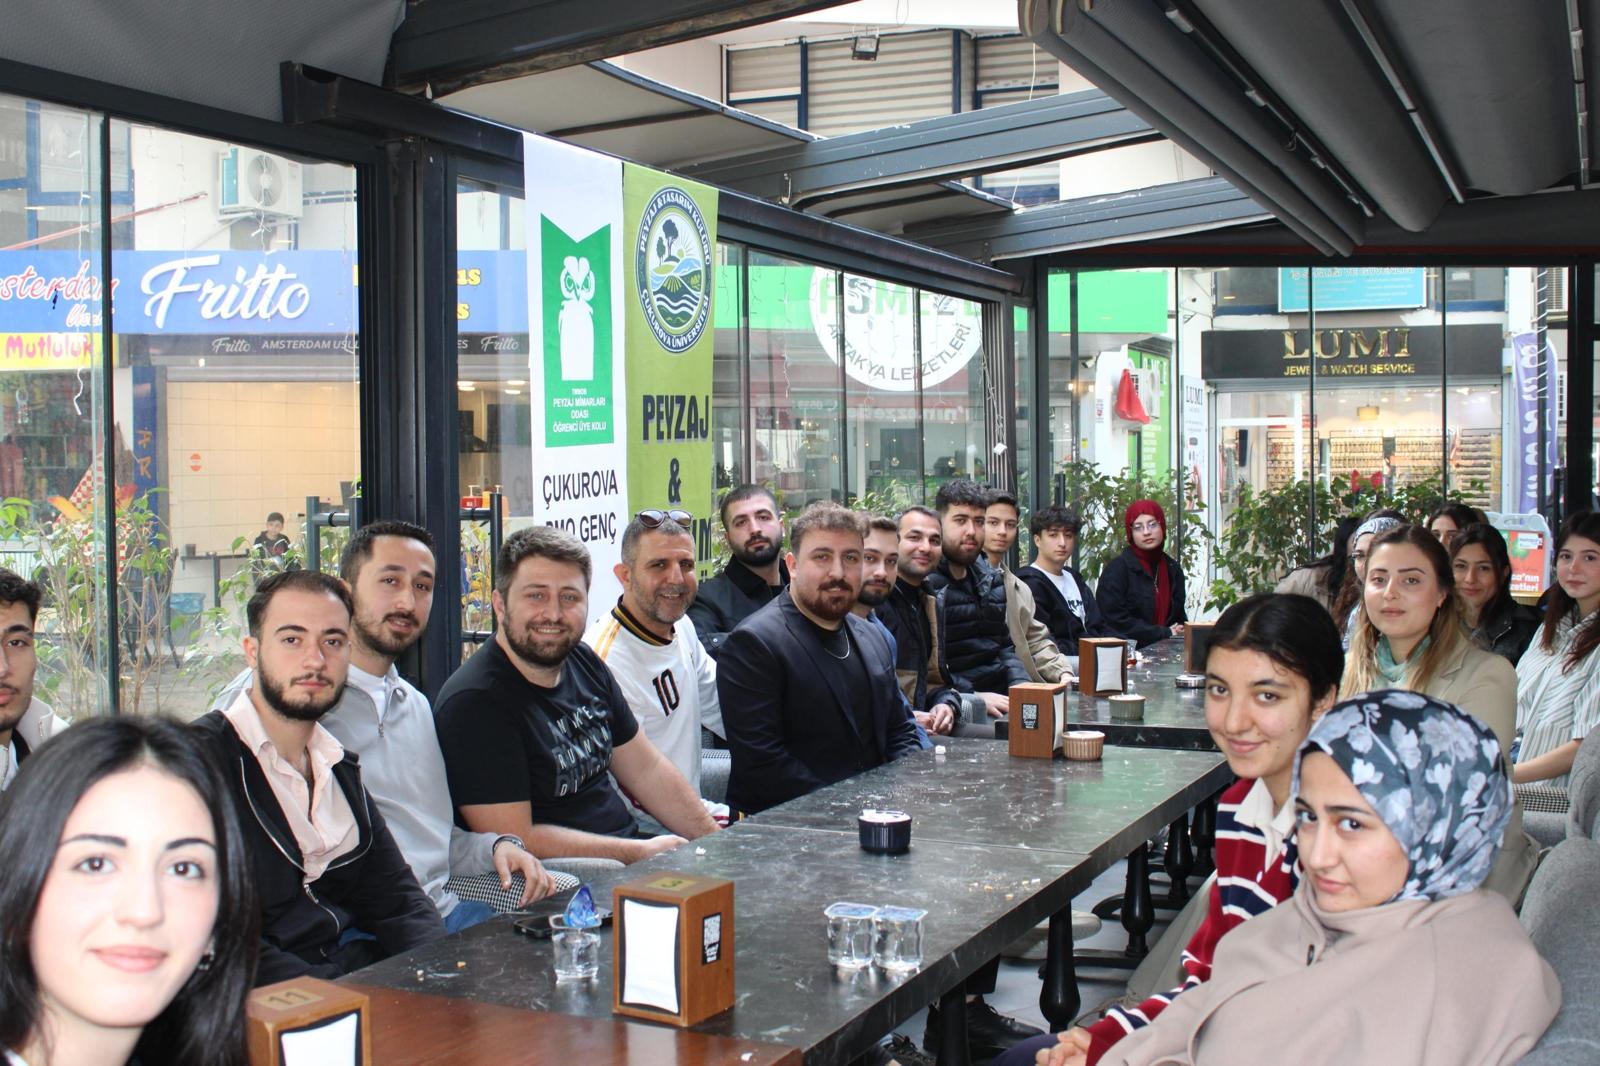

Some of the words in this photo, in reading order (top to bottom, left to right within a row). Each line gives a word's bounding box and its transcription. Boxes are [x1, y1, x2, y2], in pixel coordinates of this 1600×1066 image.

[639, 203, 658, 252] PEYZAJ
[661, 190, 693, 213] TASARIM
[691, 207, 712, 265] KULÜBÜ
[0, 259, 119, 300] sterda
[140, 254, 310, 329] Fritto
[641, 288, 672, 348] ÇUKUROVA
[6, 334, 92, 359] Mutluluk
[211, 336, 250, 354] Fritto
[261, 339, 331, 350] AMSTERDAM
[333, 339, 360, 350] USUL
[480, 335, 520, 352] Fritto
[827, 322, 886, 380] ATAKYA
[1282, 328, 1412, 360] LUMI
[1331, 364, 1368, 376] WATCH
[1370, 363, 1415, 374] SERVICE
[553, 397, 574, 408] PEYZAJ
[570, 409, 589, 419] ODASI
[642, 394, 709, 441] PEYZAJ
[591, 420, 607, 431] KOLU
[543, 469, 618, 510] ÇUKUROVA
[668, 457, 682, 503] &
[579, 511, 617, 544] GENÇ
[652, 668, 680, 717] 10
